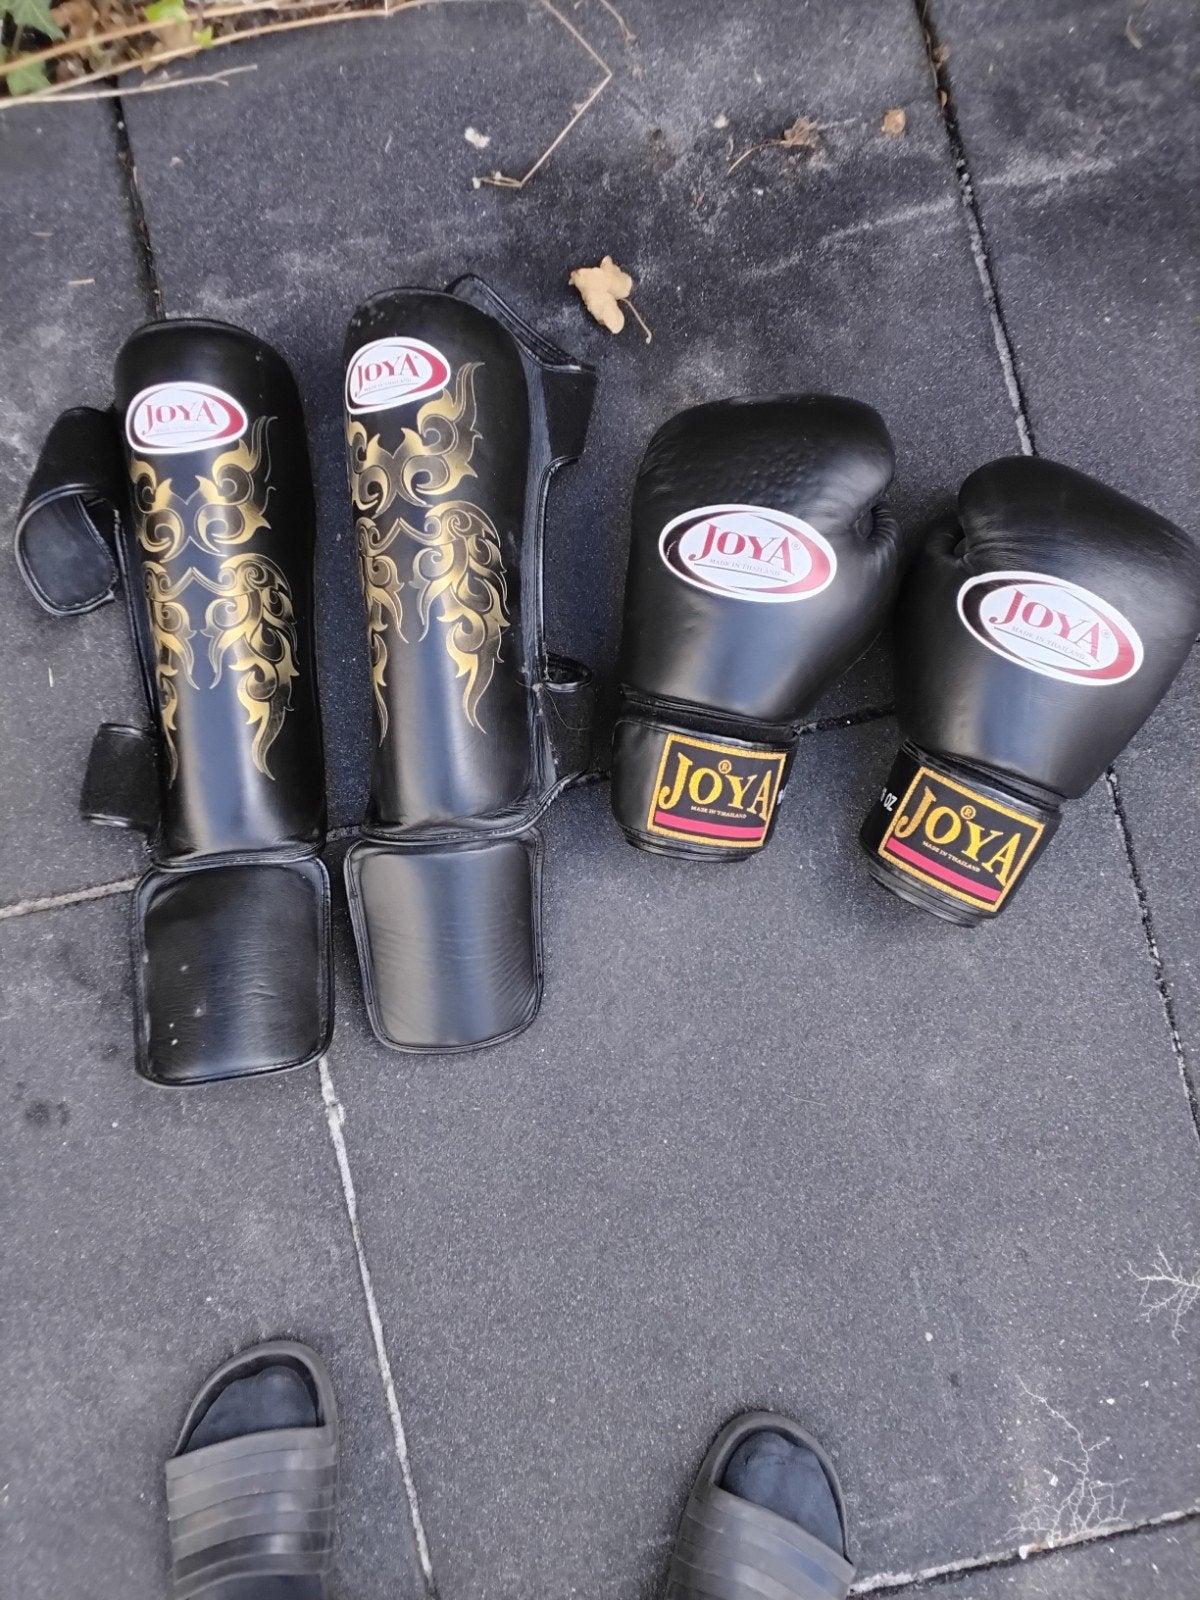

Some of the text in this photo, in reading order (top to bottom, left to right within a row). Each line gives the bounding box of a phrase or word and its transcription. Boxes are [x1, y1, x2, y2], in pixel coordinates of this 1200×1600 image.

[354, 353, 420, 398] JOYA
[141, 400, 218, 436] JOYA
[690, 805, 708, 814] MADE
[922, 840, 940, 853] MADE
